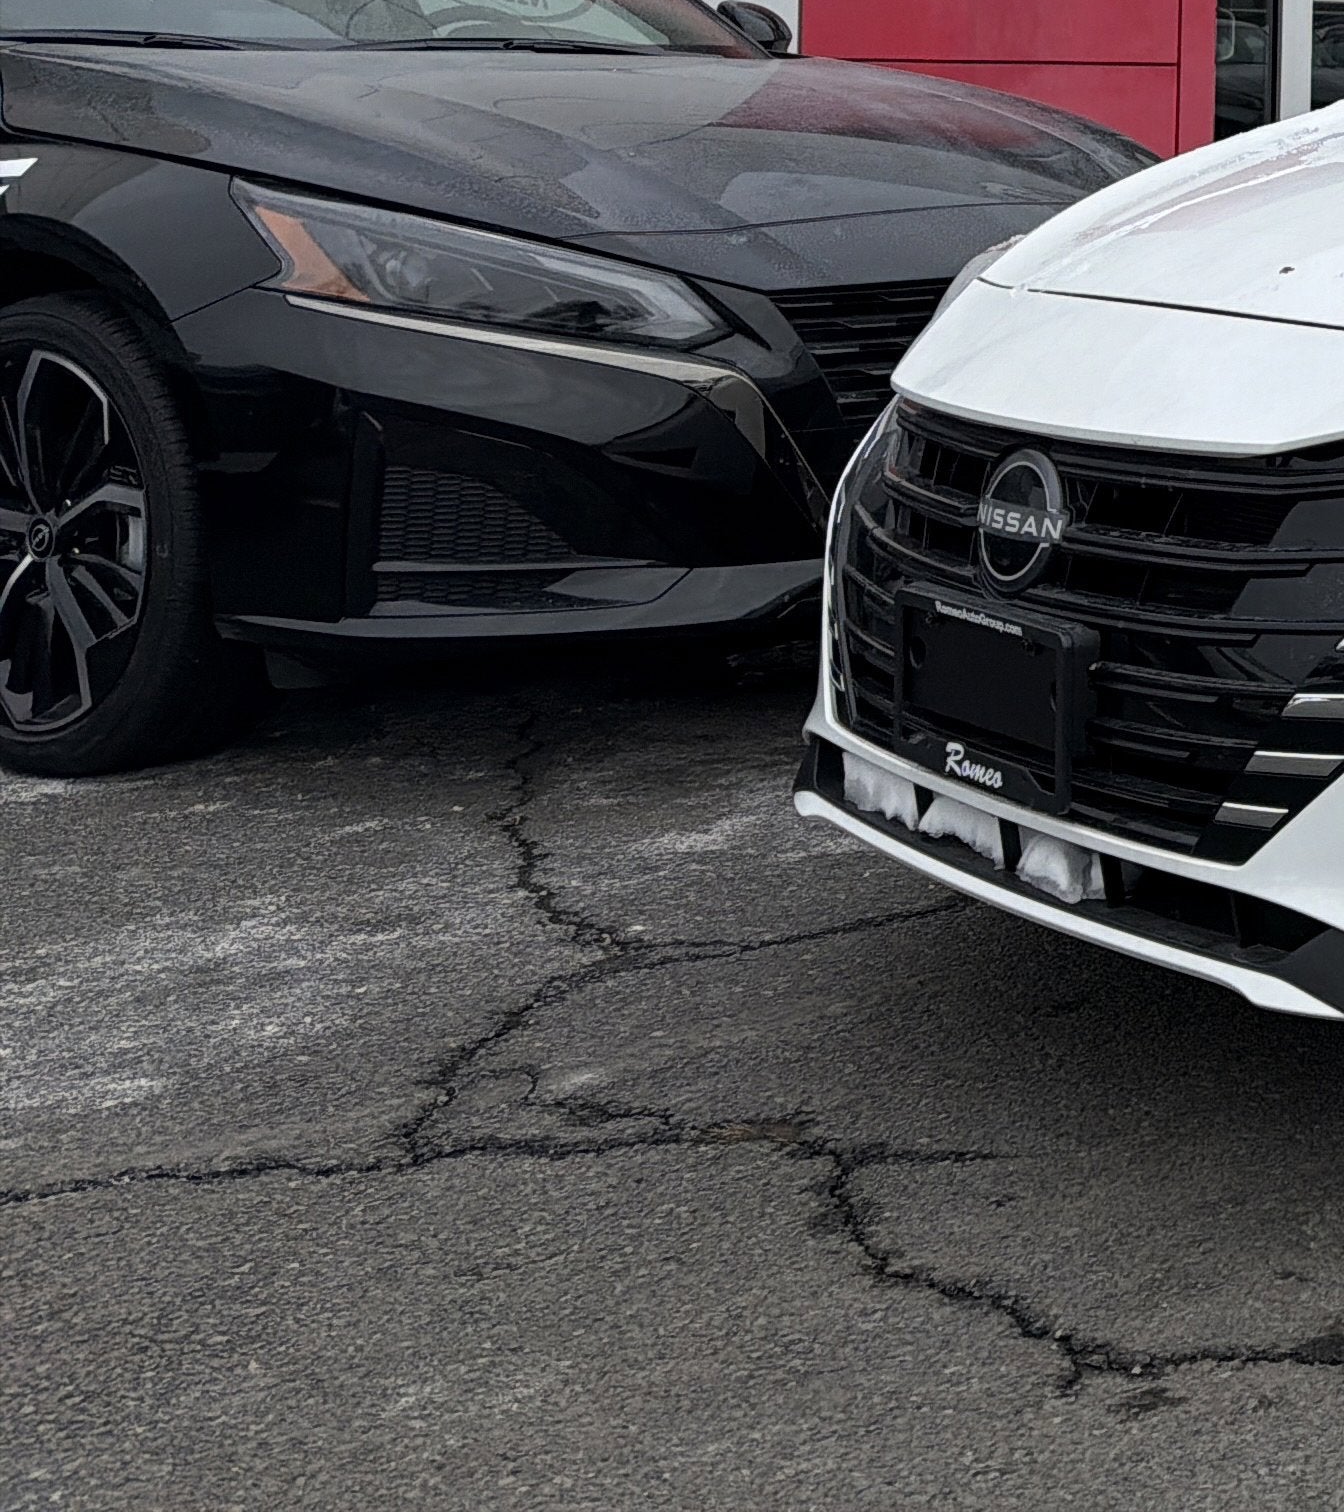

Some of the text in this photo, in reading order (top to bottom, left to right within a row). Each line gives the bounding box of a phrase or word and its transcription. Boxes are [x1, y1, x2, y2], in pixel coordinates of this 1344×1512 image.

[976, 502, 1063, 540] NISSAN
[934, 600, 1023, 637] RomeoAutoGroup.com
[944, 741, 1003, 789] Romeo
